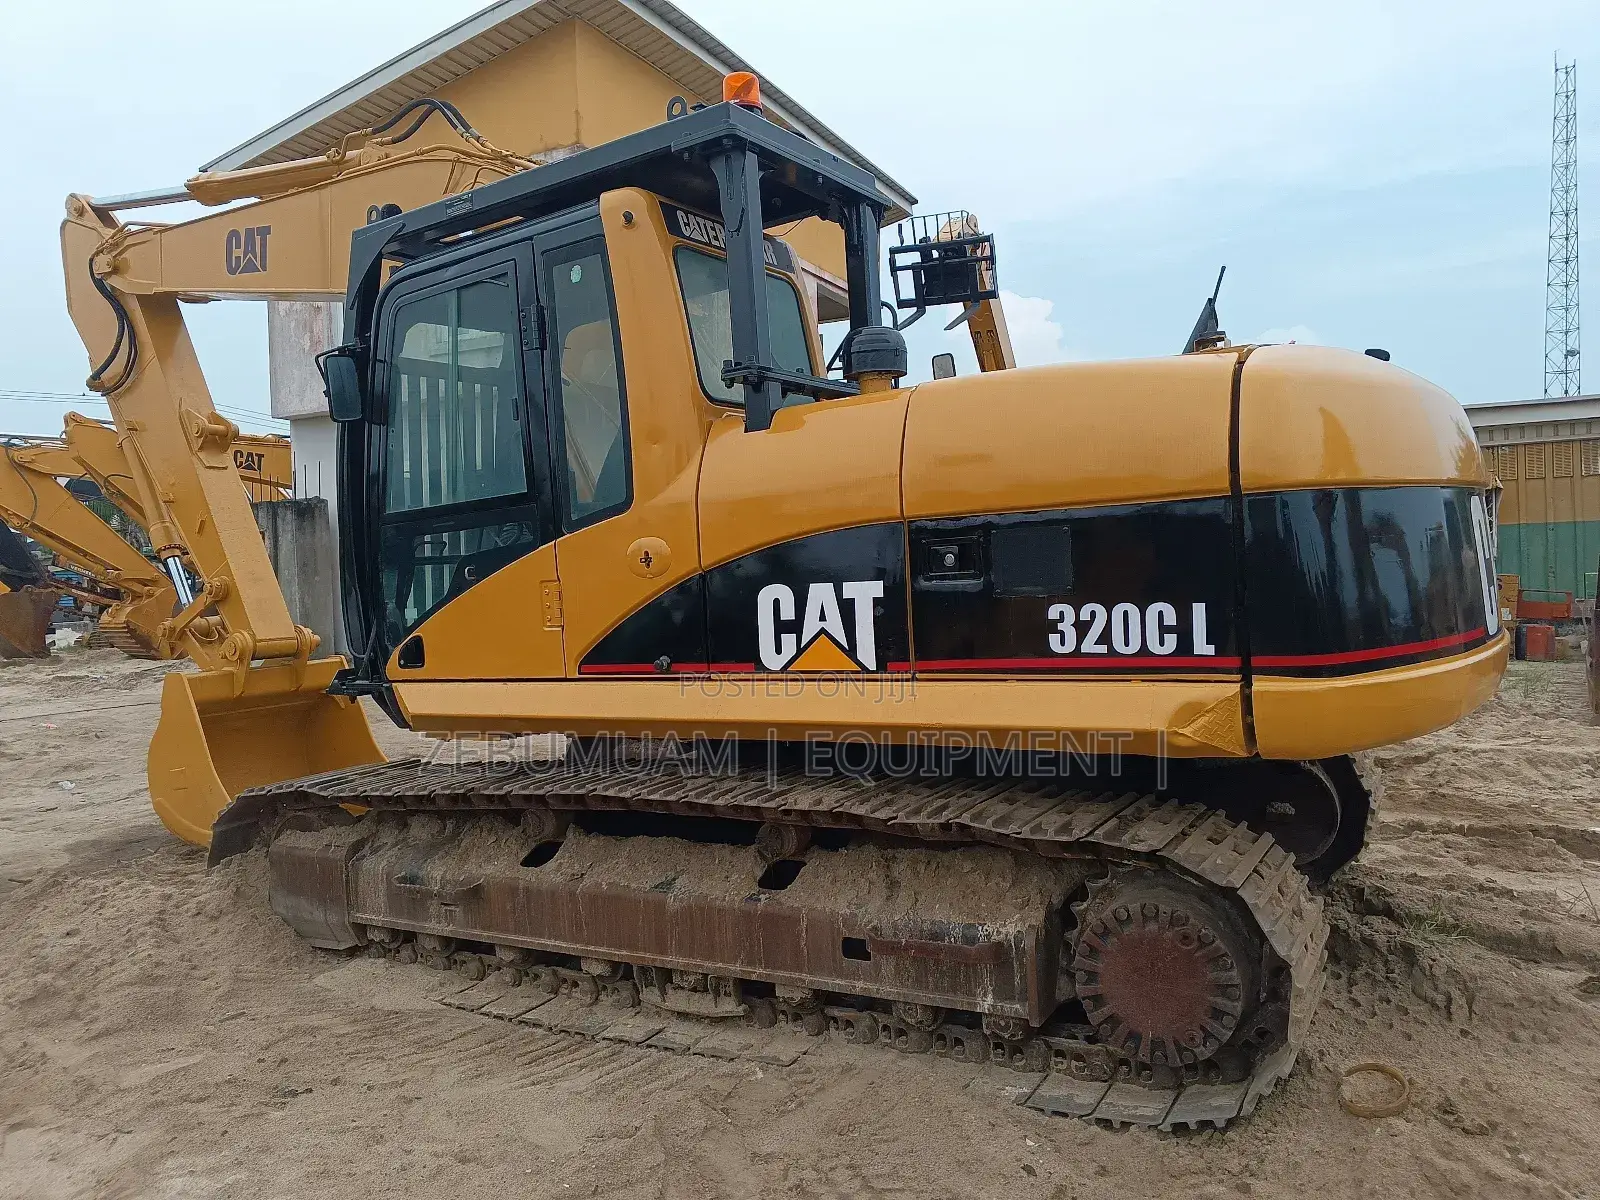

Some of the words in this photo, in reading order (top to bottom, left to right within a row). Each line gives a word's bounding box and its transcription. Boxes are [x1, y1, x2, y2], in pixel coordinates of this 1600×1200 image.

[225, 225, 271, 275] CAT
[233, 449, 265, 472] CAT
[757, 580, 884, 671] CAT
[1047, 601, 1178, 655] 320C
[1192, 602, 1216, 656] L
